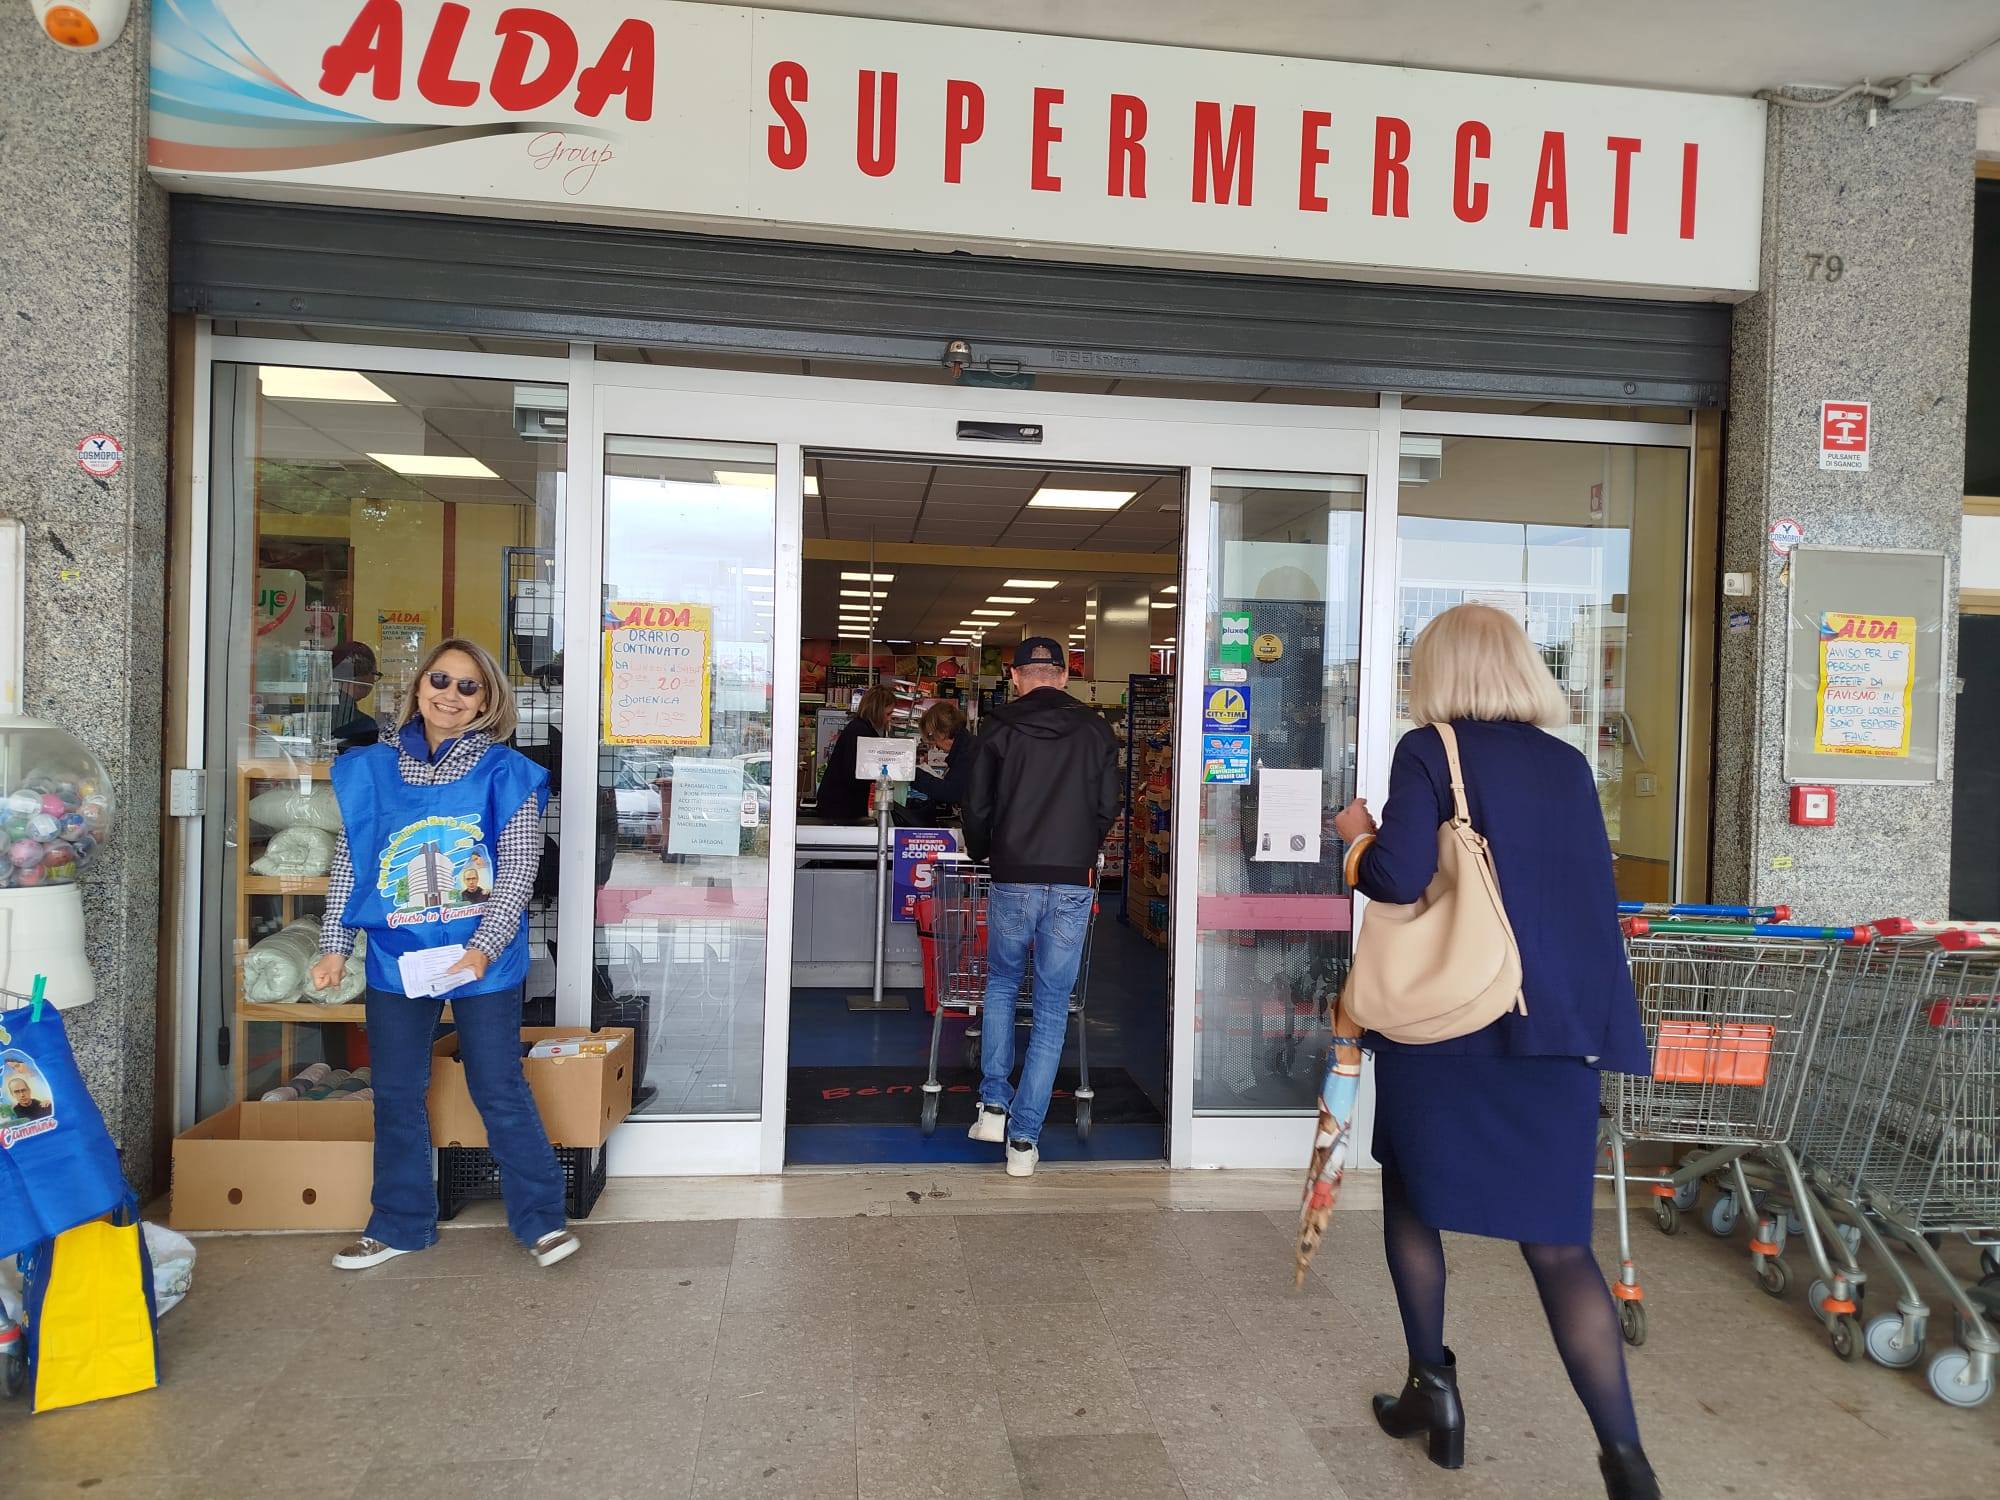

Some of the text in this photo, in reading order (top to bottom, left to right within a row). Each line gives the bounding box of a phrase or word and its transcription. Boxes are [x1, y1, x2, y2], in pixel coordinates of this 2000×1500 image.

[319, 0, 655, 121] ALDA
[767, 60, 1699, 240] SUPERMERCATI
[527, 131, 616, 196] Group
[1807, 252, 1845, 283] 79
[79, 451, 119, 460] COSMOPOL
[1827, 453, 1861, 461] PULSANTE
[1825, 460, 1862, 469] DI SGANCIO
[388, 613, 420, 622] ALDA
[624, 606, 691, 627] ALDA
[1838, 619, 1898, 639] ALDA
[629, 630, 680, 643] ORARIO
[614, 641, 690, 657] CONTINUATO
[1829, 648, 1860, 659] AVVISO
[1864, 648, 1882, 658] PER
[615, 660, 629, 670] DA
[1827, 661, 1871, 672] PERSONE
[619, 694, 680, 707] DOMENICA
[1826, 705, 1864, 716] QUESTO
[908, 844, 946, 852] BUONO
[902, 851, 929, 859] SCON
[914, 863, 932, 888] 5
[388, 912, 424, 928] Chiesa
[427, 912, 438, 921] in
